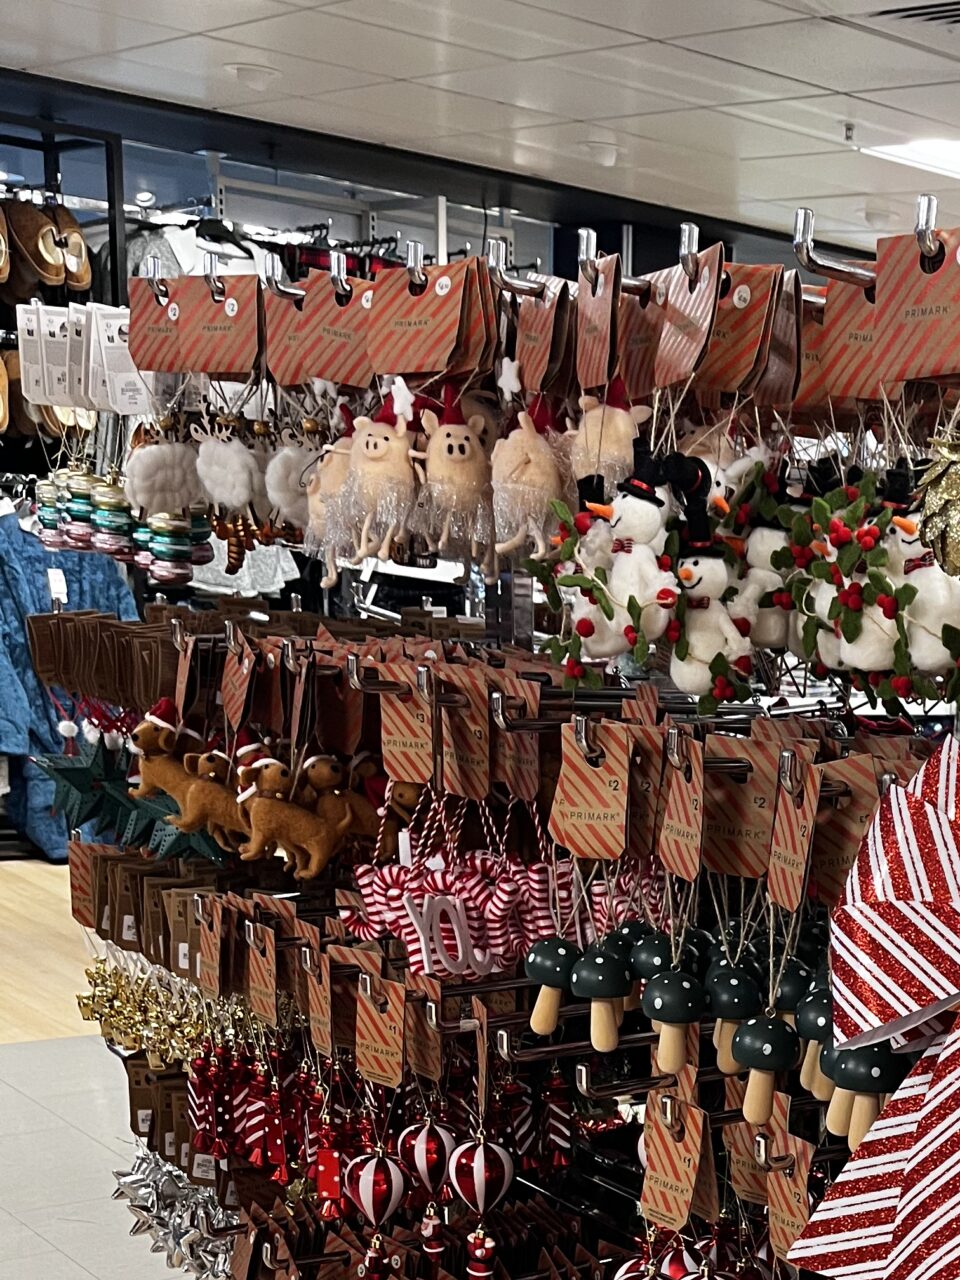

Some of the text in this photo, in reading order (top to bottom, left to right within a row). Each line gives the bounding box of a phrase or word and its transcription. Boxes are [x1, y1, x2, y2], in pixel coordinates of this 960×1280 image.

[905, 306, 949, 319] PRIMARK
[387, 740, 426, 749] PRIMARK
[608, 780, 620, 791] £2
[754, 797, 767, 809] £2
[570, 811, 617, 821] PRIMARK
[665, 823, 697, 840] PRIMARK
[706, 824, 762, 840] PRIMARK
[361, 1043, 396, 1058] PRIMARK
[649, 1175, 686, 1194] PRIMARK
